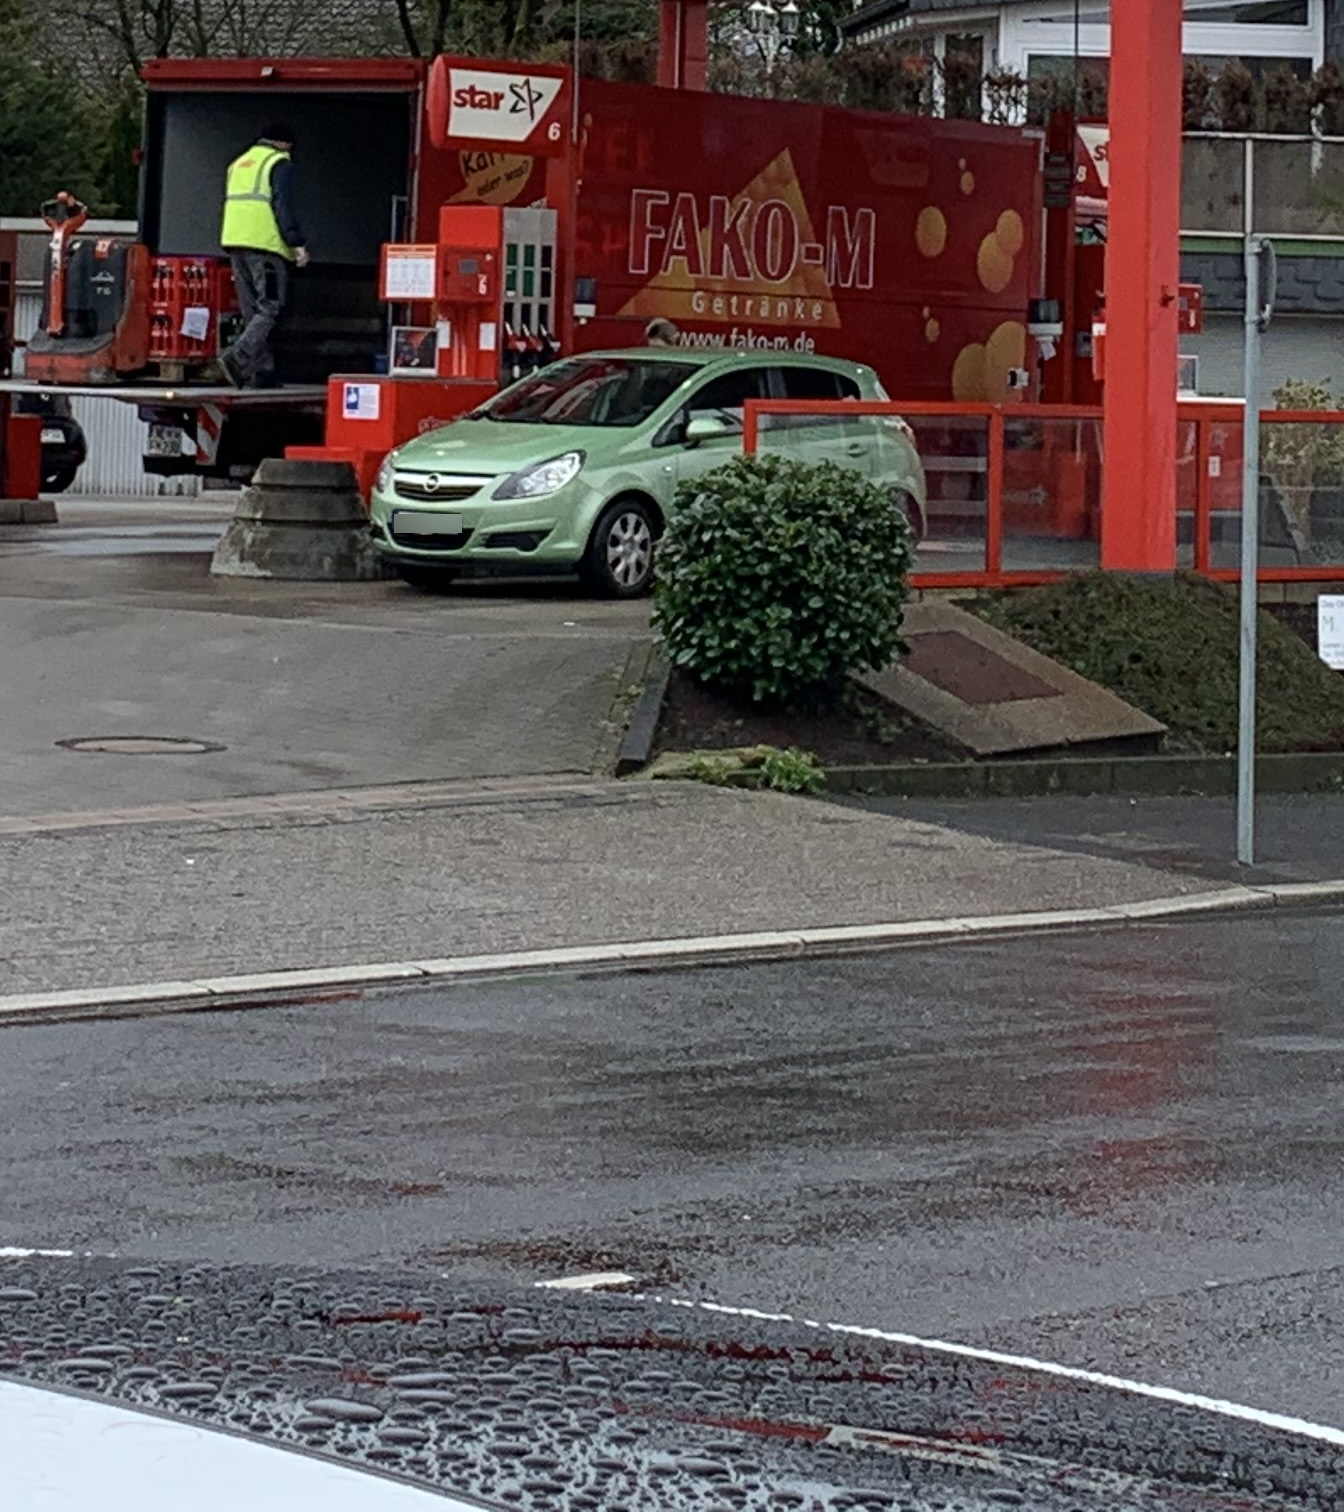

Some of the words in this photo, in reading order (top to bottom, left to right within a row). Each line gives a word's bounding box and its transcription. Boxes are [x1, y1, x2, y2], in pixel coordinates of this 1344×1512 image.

[453, 84, 505, 112] star
[547, 122, 561, 141] 6
[627, 188, 877, 290] FAKO-M
